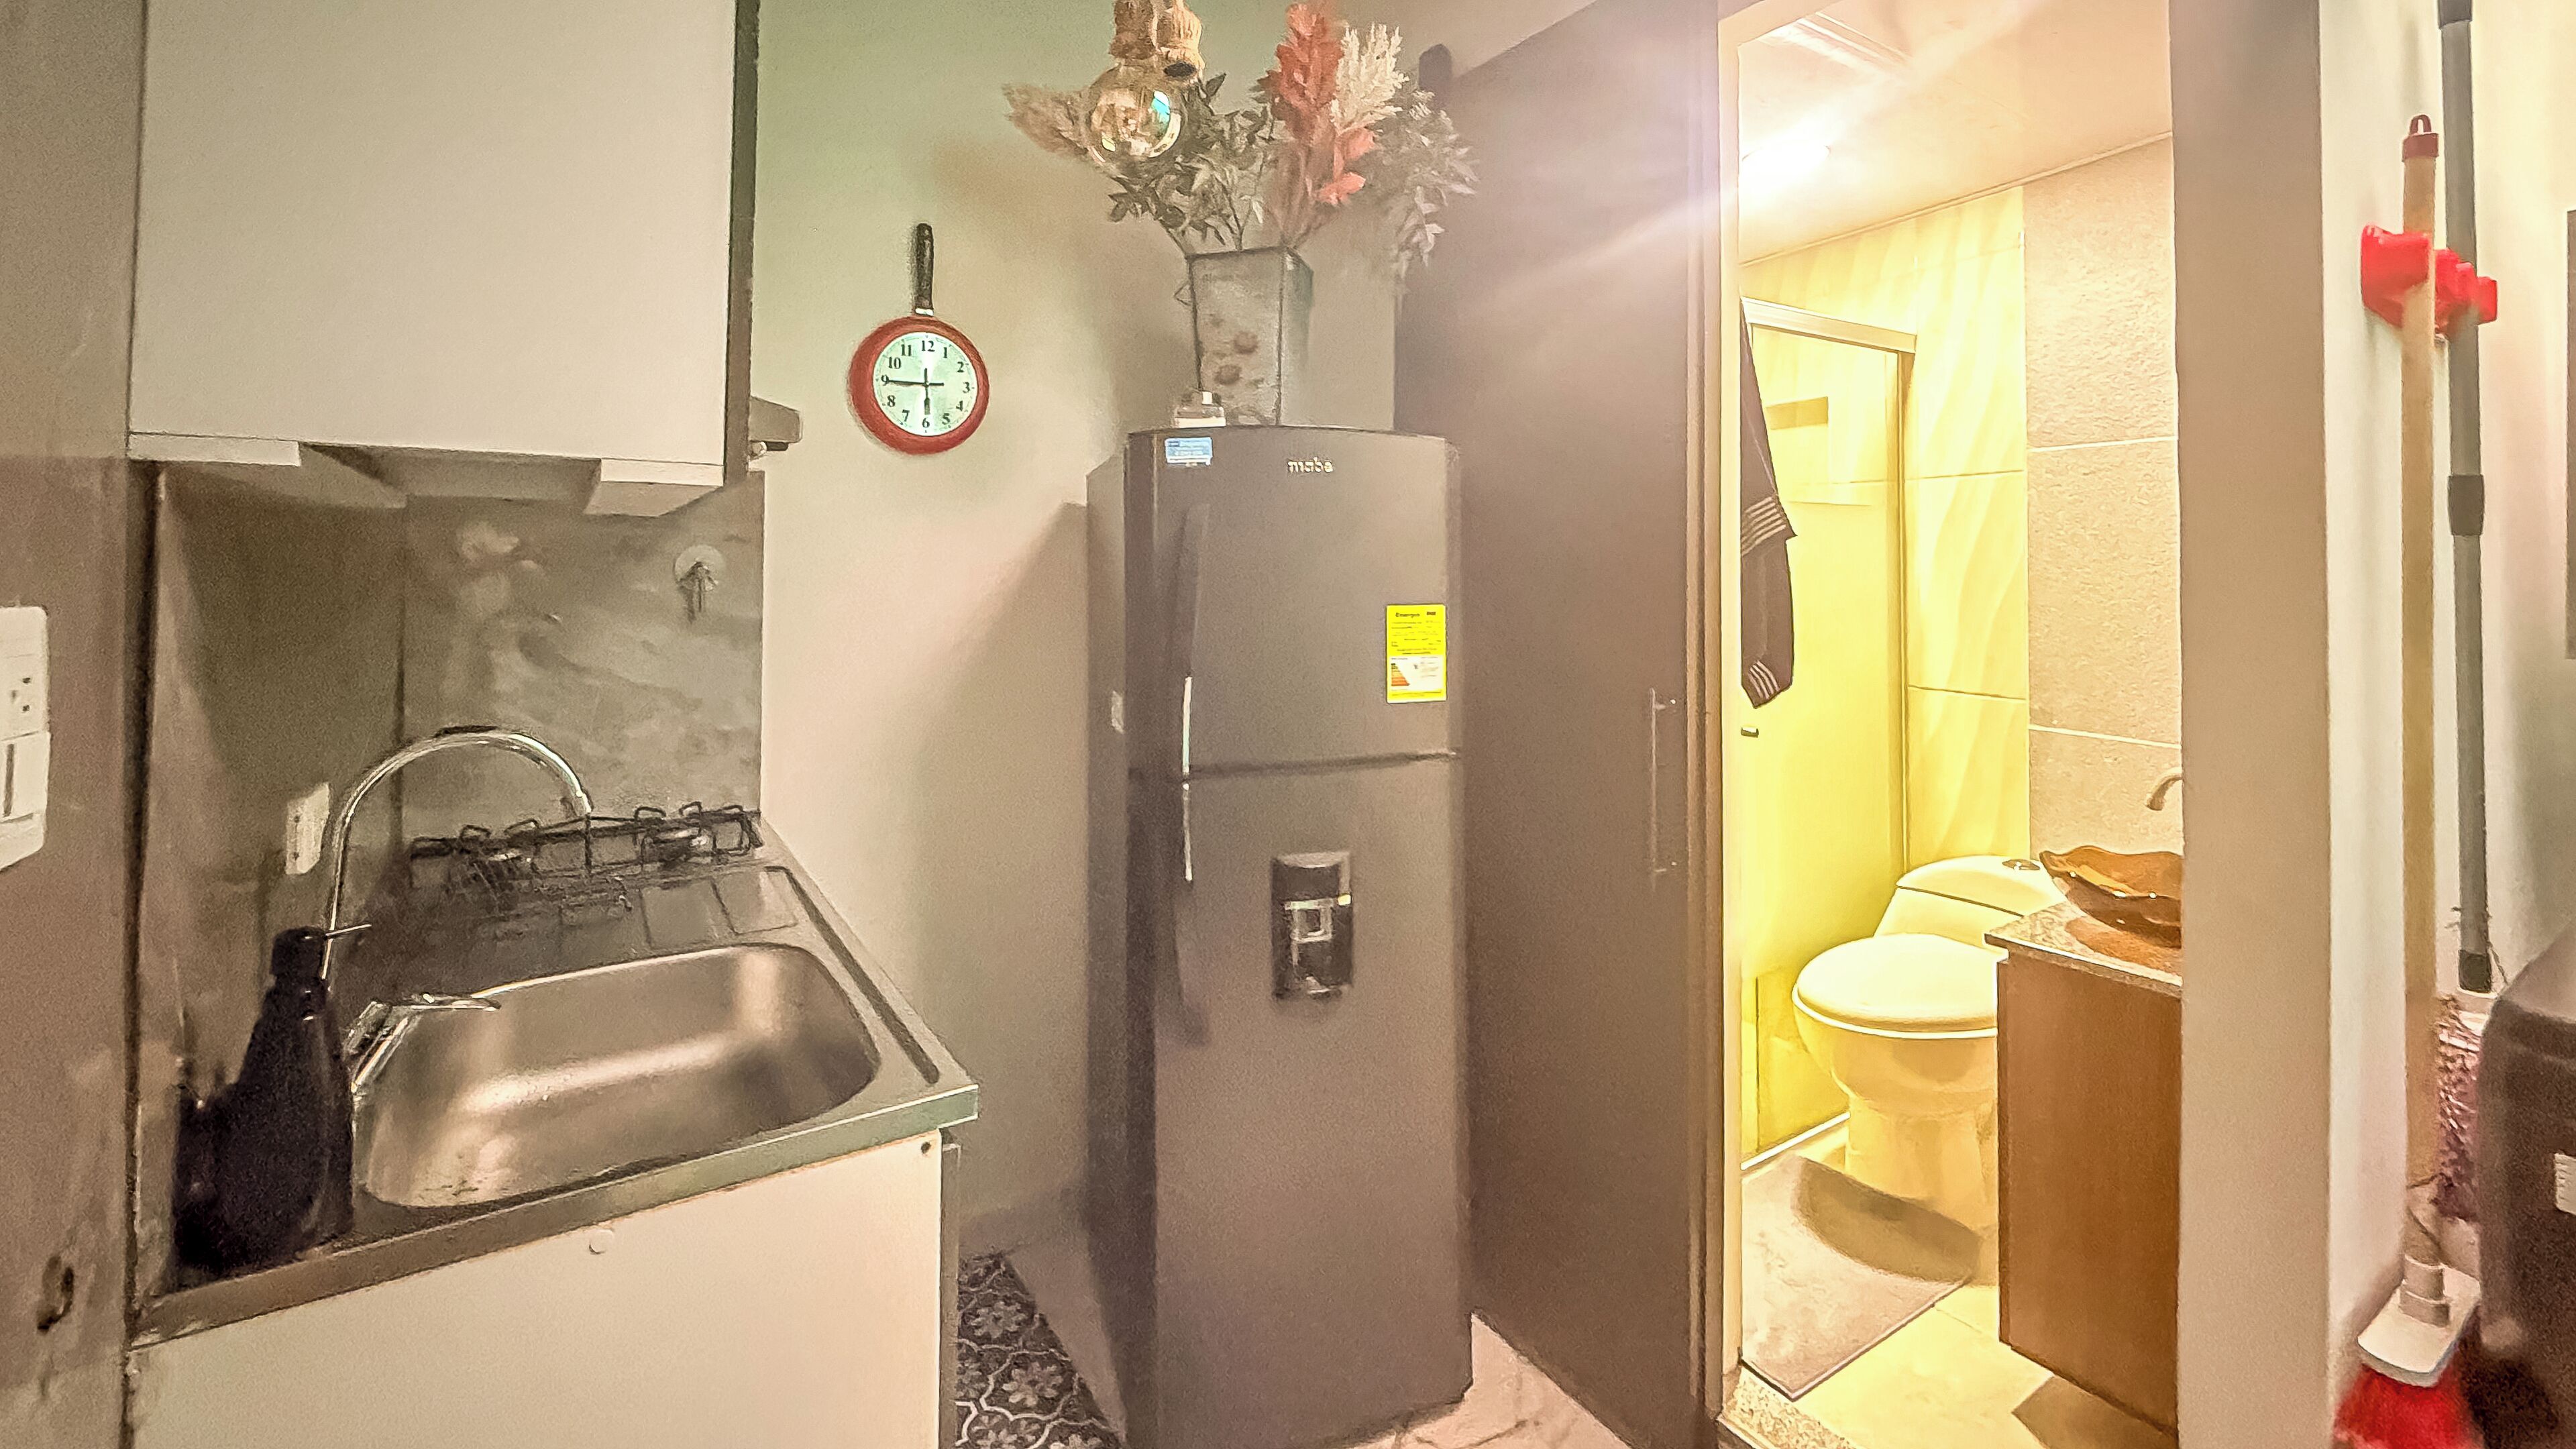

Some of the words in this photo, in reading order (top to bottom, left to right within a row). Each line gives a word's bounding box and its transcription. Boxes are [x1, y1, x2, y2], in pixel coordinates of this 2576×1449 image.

[901, 344, 912, 356] 11
[921, 340, 935, 352] 12
[943, 347, 948, 358] 1
[888, 357, 902, 369] 10
[957, 362, 964, 373] 2
[881, 374, 889, 386] 9
[963, 382, 970, 393] 3
[887, 395, 896, 407] 8
[956, 400, 963, 411] 4
[902, 409, 910, 422] 7
[942, 413, 950, 425] 5
[922, 417, 930, 428] 6
[1287, 457, 1333, 472] mabe
